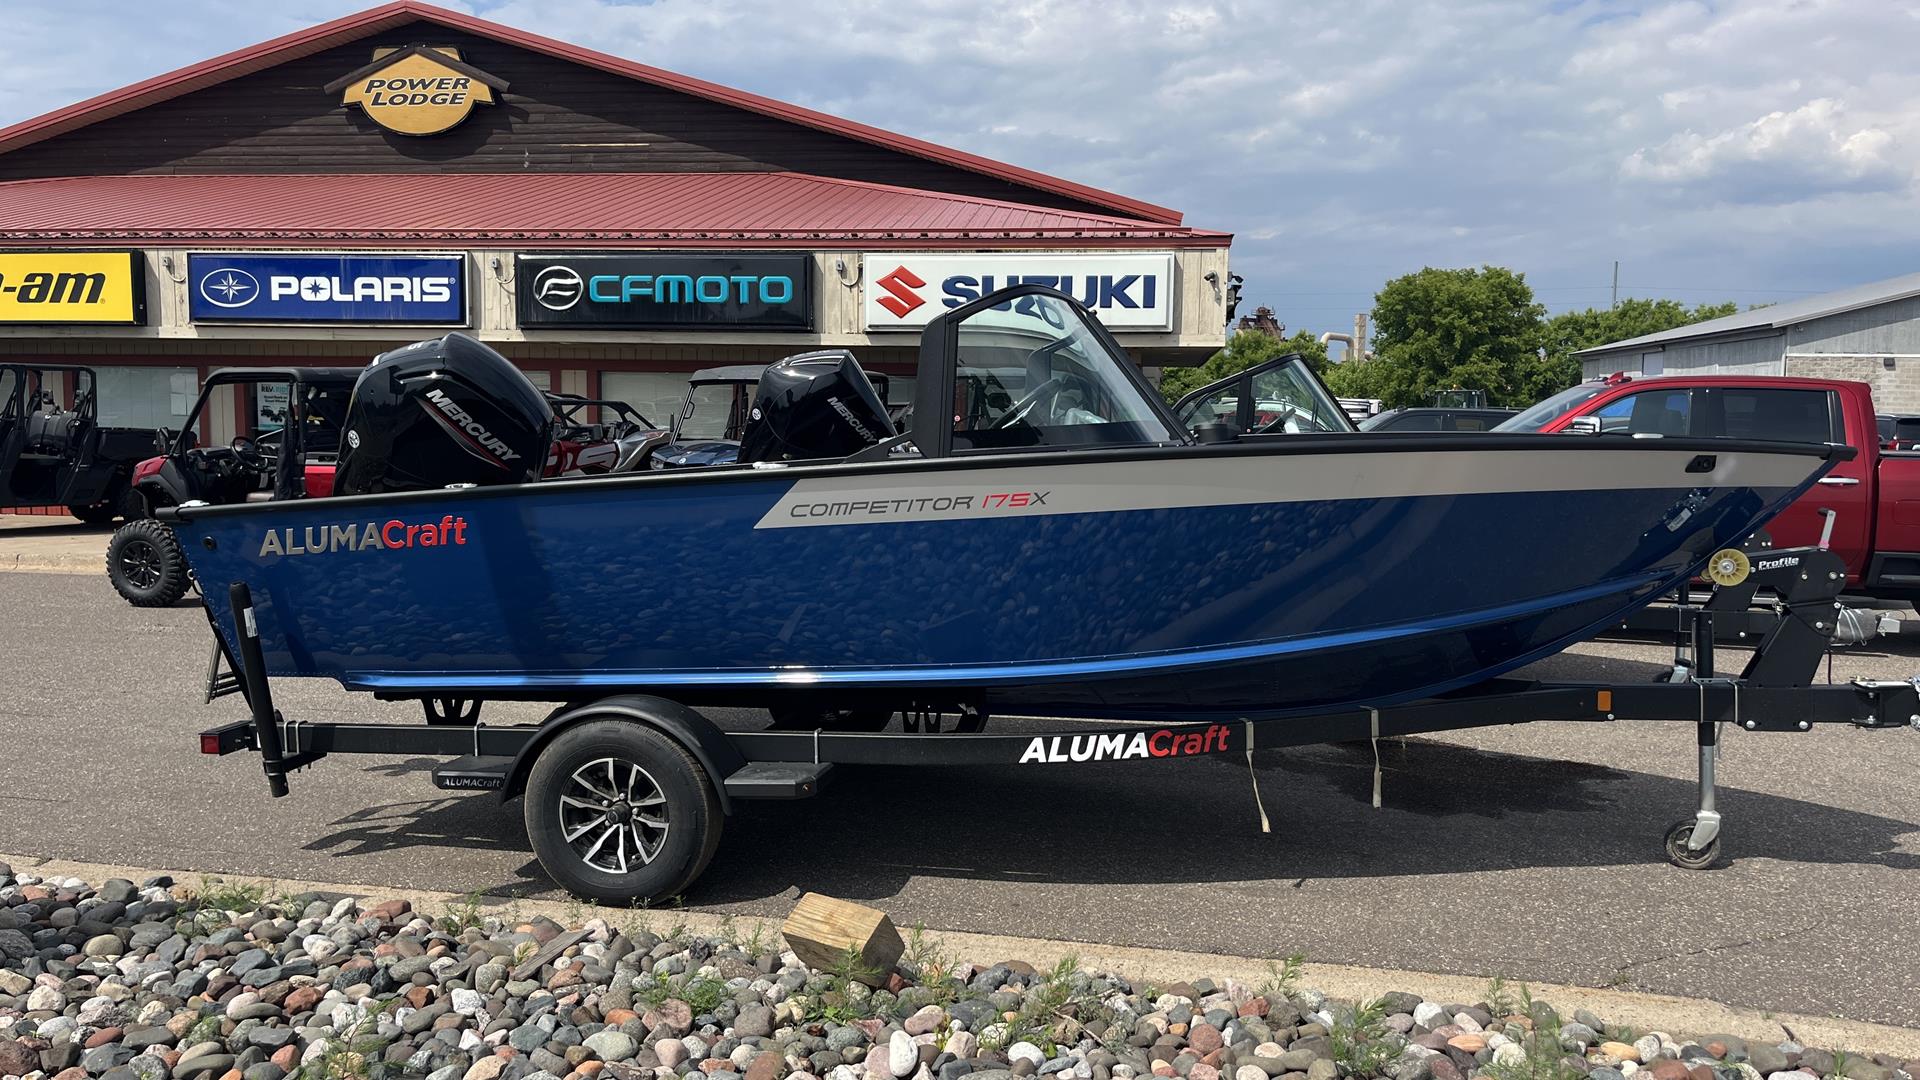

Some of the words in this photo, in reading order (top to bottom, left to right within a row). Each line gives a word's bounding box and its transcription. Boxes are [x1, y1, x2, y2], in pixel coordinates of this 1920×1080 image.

[364, 77, 471, 93] POWER
[370, 92, 467, 106] LODGE
[0, 273, 105, 303] -am
[271, 276, 451, 302] POLARIS
[589, 274, 793, 304] CFMOTO
[941, 274, 1156, 312] SUZUKI
[426, 388, 521, 462] MERCURY
[827, 396, 878, 443] MERCURY
[790, 496, 975, 518] COMPETITOR
[982, 491, 1051, 509] 175X
[258, 515, 467, 557] ALUMACraft
[1758, 556, 1800, 569] Profile
[1018, 725, 1230, 764] ALUMACraft
[443, 778, 500, 787] ALUMACraft
